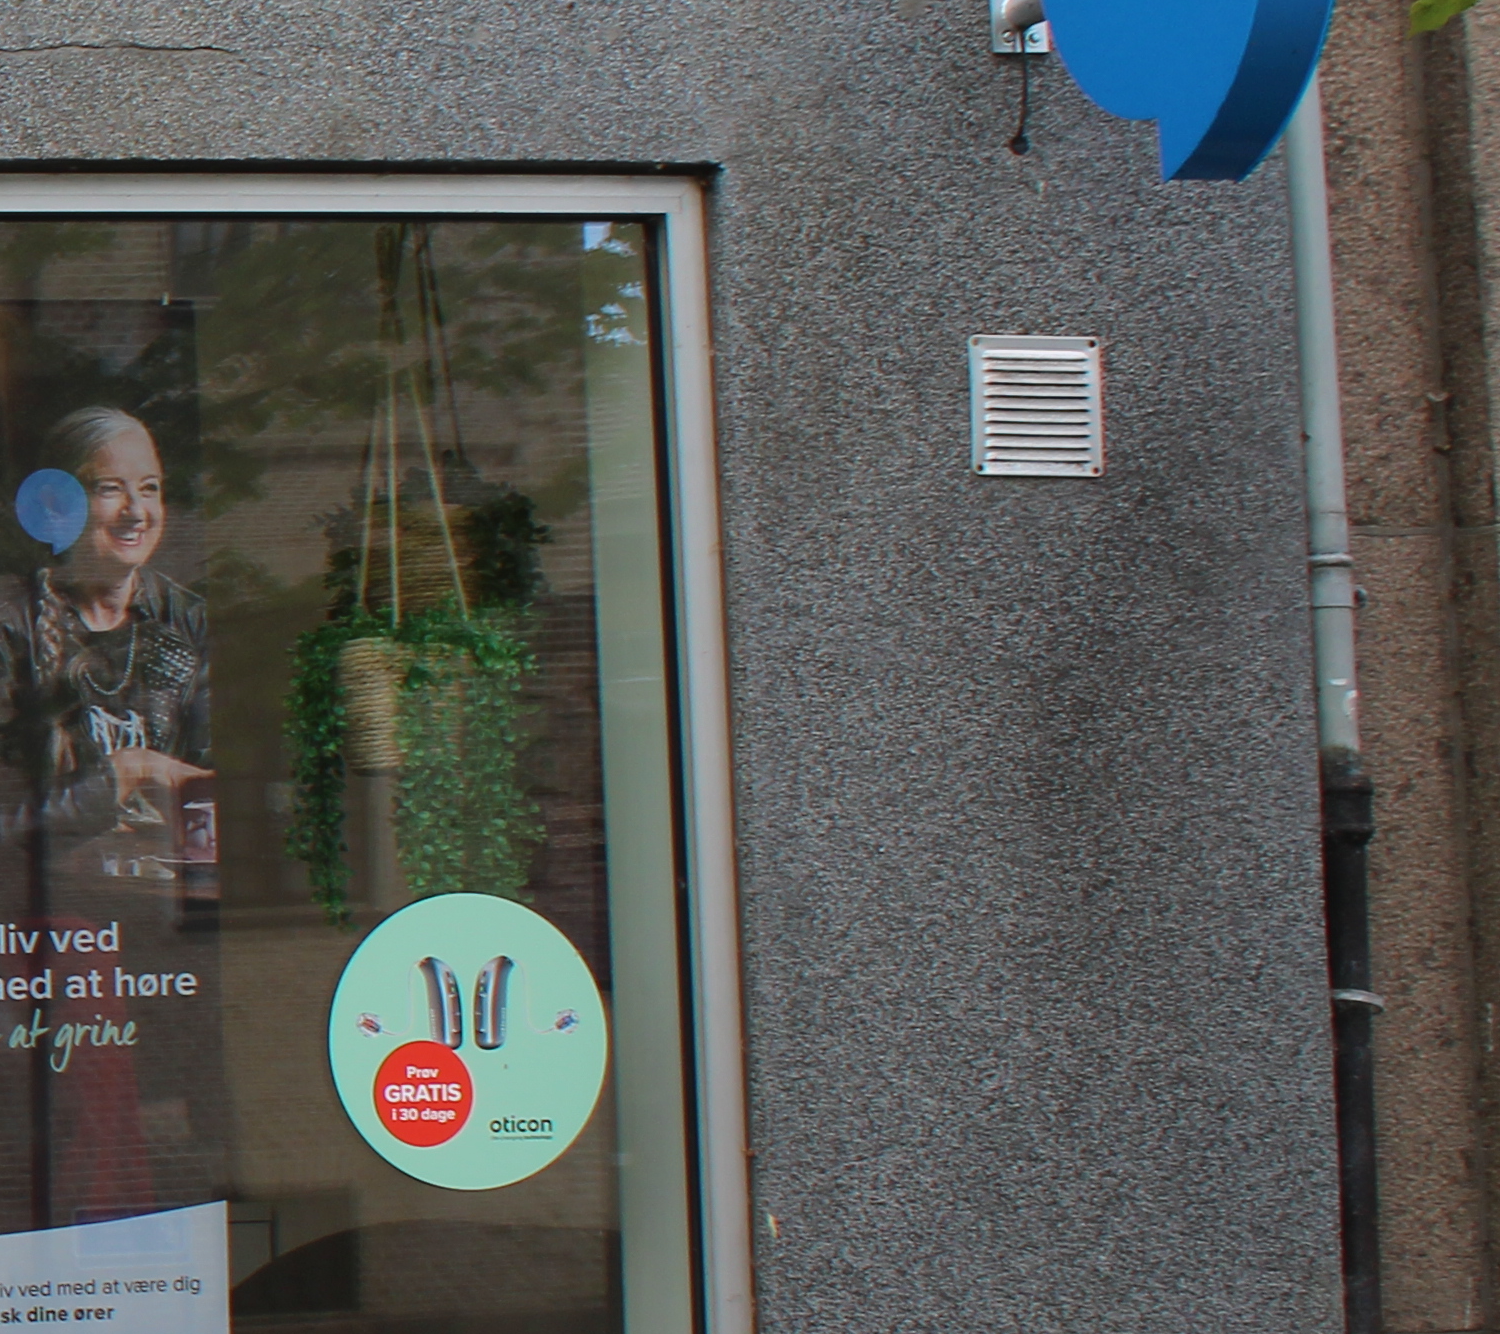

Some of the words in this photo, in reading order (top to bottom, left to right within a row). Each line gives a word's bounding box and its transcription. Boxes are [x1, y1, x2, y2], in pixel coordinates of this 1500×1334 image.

[49, 921, 120, 953] ved
[65, 970, 103, 998] at
[114, 967, 198, 997] høre
[8, 1008, 51, 1048] at
[50, 1014, 140, 1073] grine
[406, 1066, 439, 1079] Prøv
[384, 1084, 462, 1102] GRATIS
[392, 1108, 397, 1121] i
[399, 1109, 418, 1121] 30
[421, 1108, 456, 1124] dage
[490, 1115, 553, 1133] oticon
[18, 1281, 51, 1297] ved
[57, 1279, 95, 1295] med
[102, 1279, 120, 1294] at
[124, 1278, 167, 1293] være
[173, 1276, 201, 1295] dig
[27, 1306, 68, 1322] dine
[74, 1307, 114, 1320] ører
